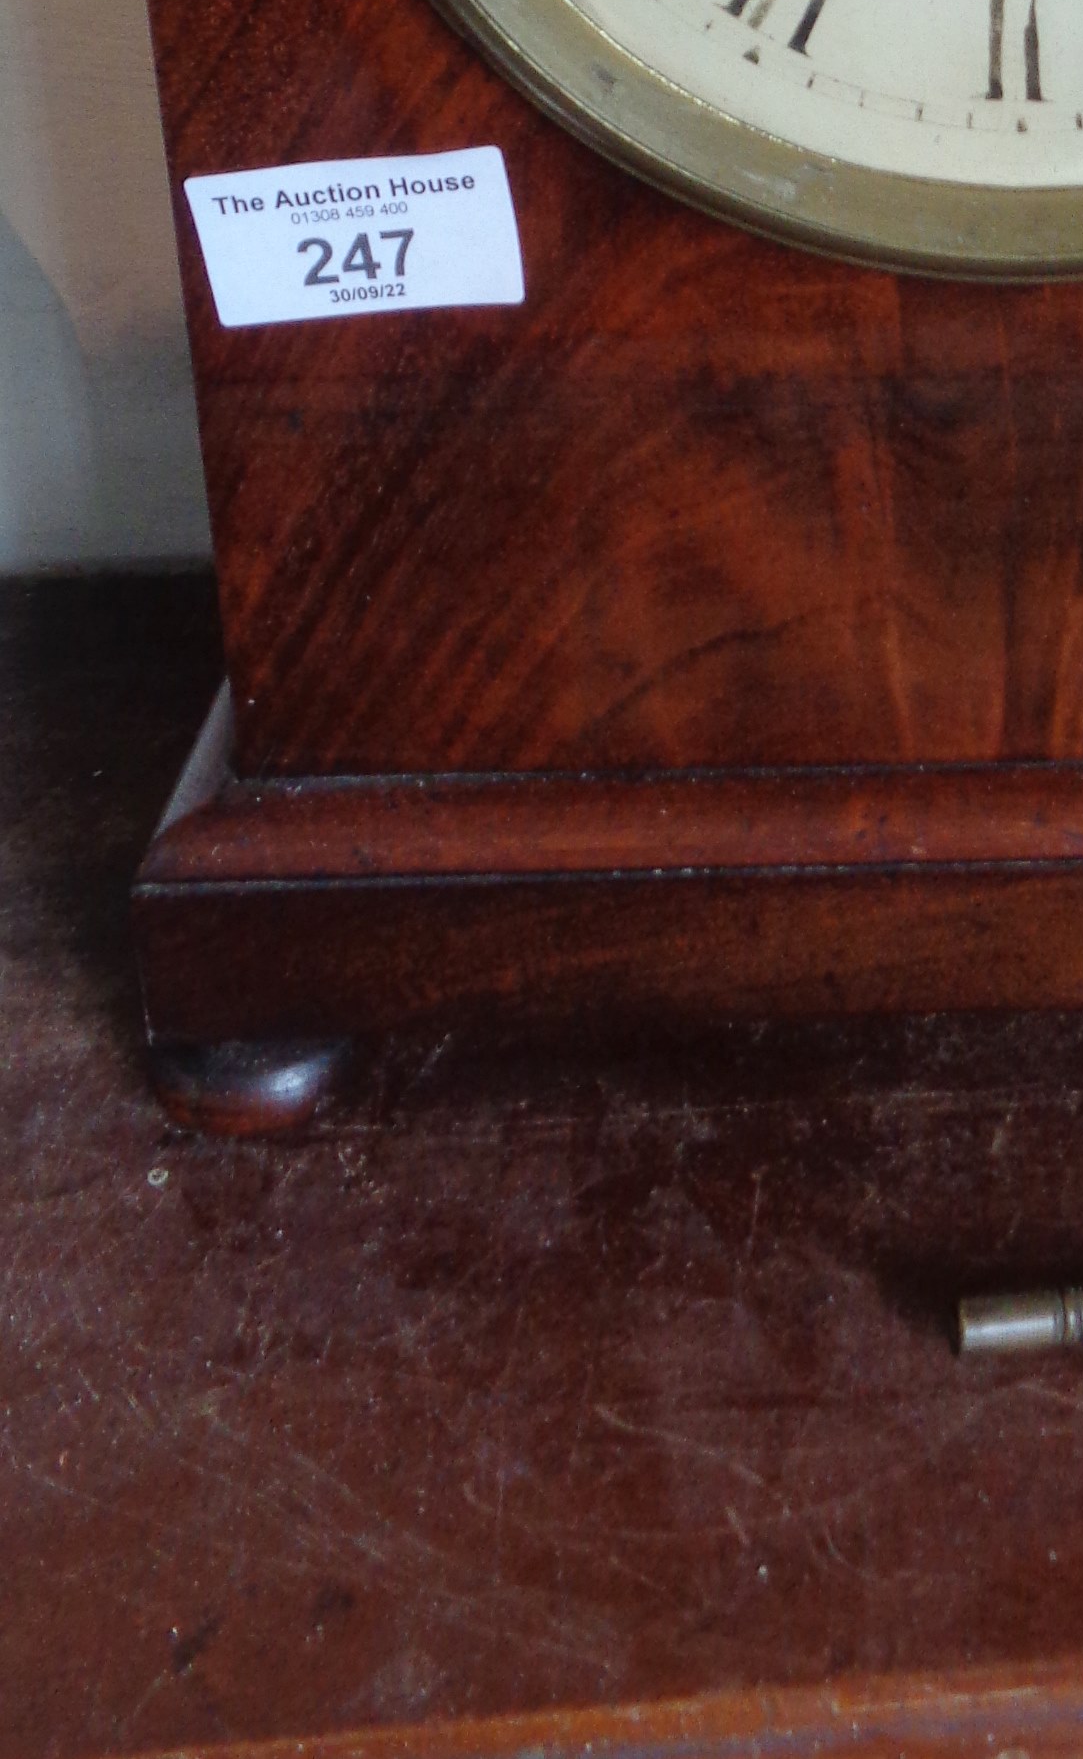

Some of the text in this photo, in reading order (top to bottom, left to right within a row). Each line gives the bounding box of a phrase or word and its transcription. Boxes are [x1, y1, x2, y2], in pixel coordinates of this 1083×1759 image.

[212, 174, 475, 216] The Auction House
[291, 201, 409, 226] 01308 459 400
[297, 228, 415, 286] 247
[329, 283, 406, 304] 30/09/22
